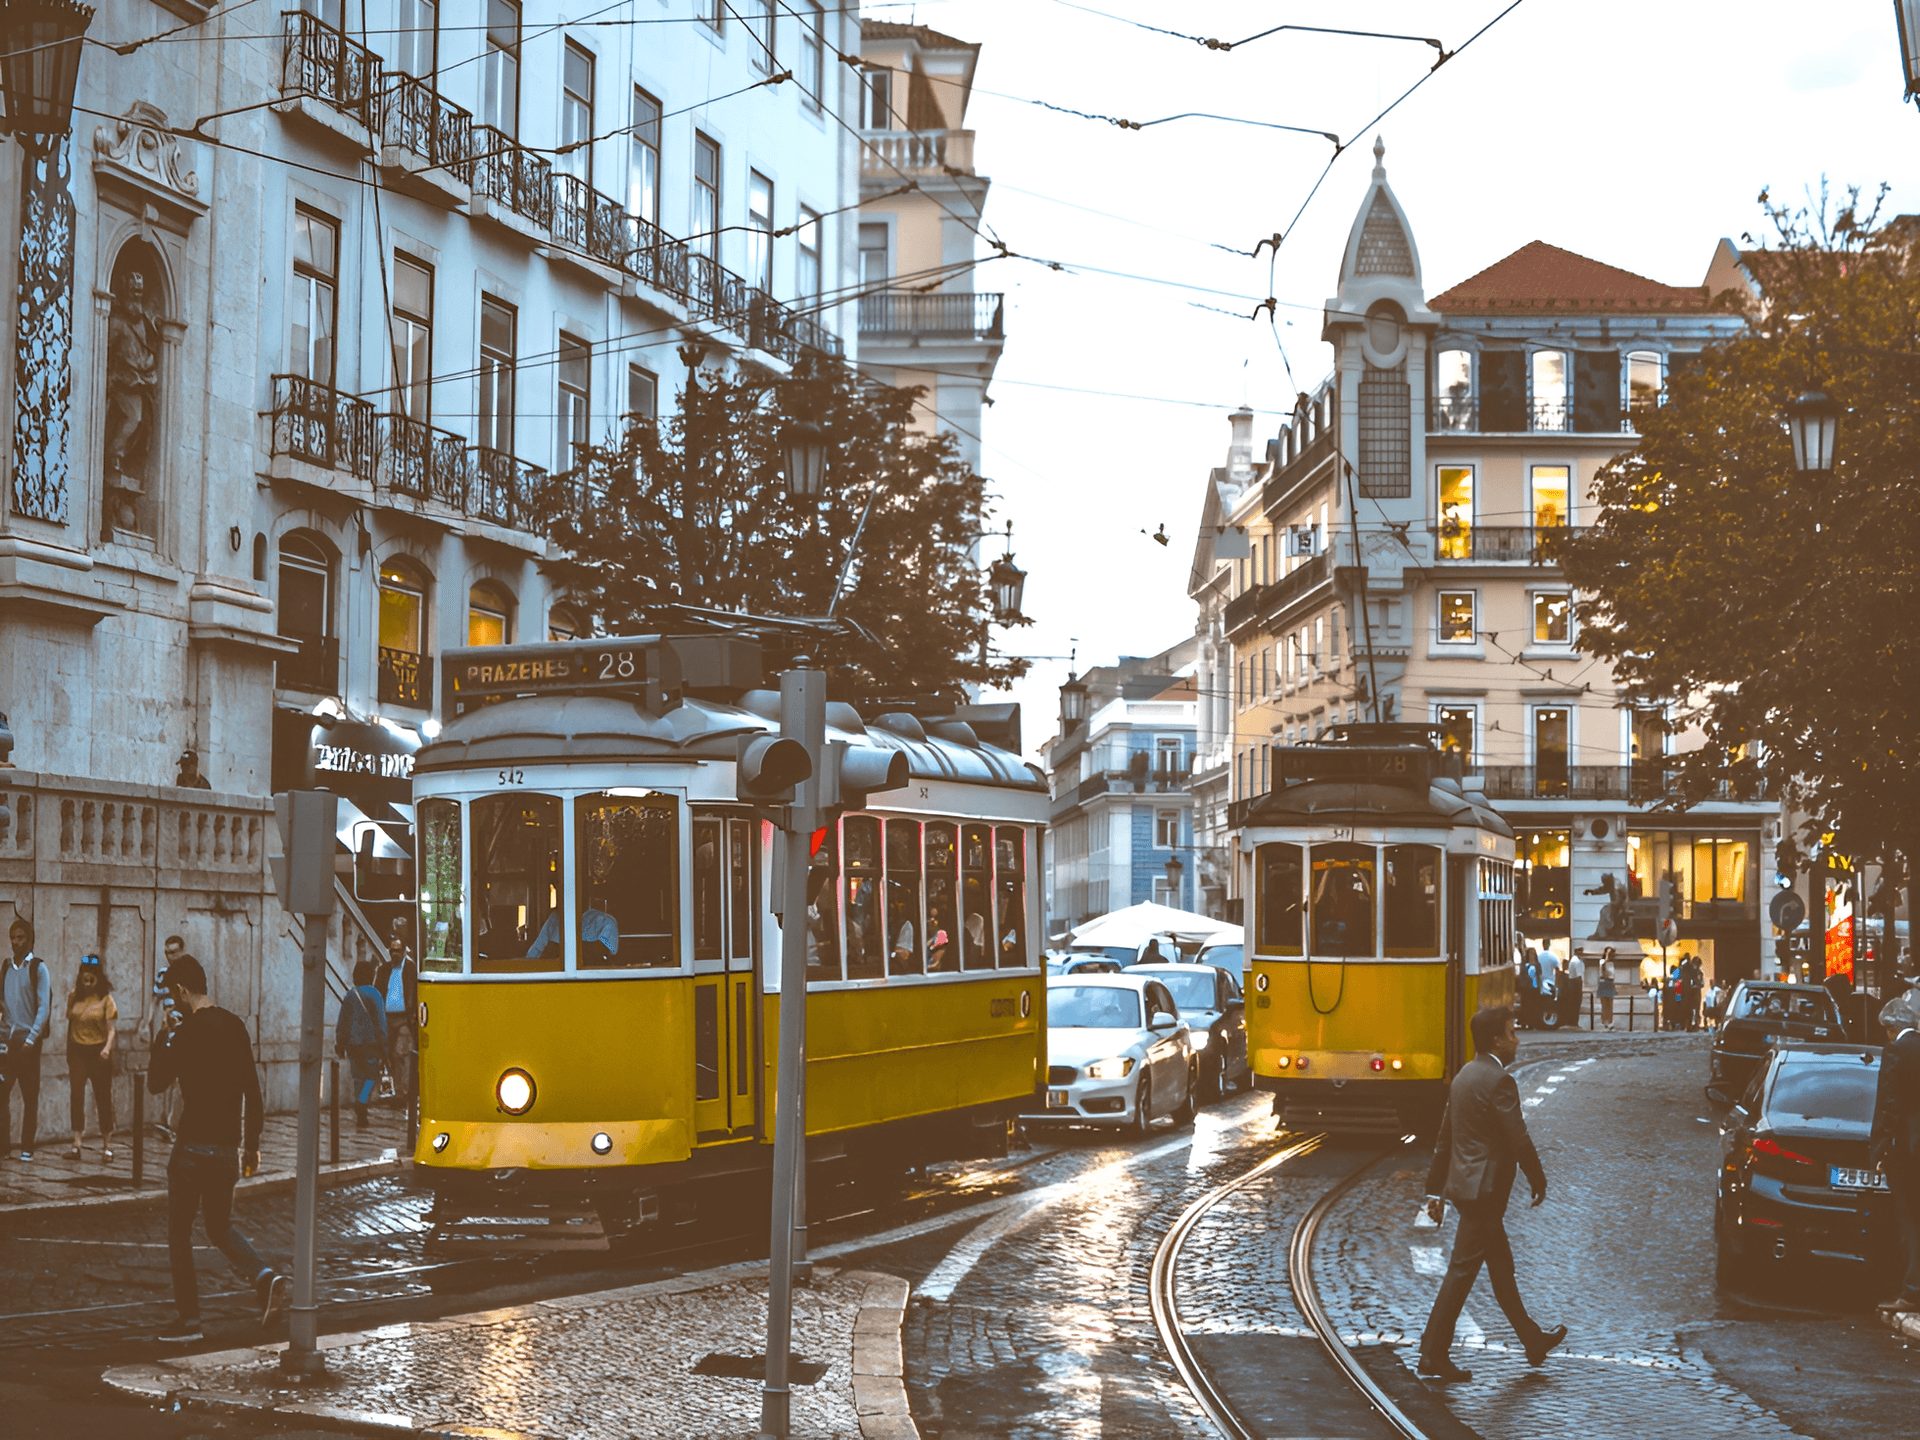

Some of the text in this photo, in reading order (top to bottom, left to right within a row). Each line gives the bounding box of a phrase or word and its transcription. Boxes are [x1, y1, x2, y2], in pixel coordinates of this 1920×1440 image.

[467, 651, 635, 683] PRAZERES 28
[1381, 756, 1406, 773] 28
[498, 769, 524, 785] 542
